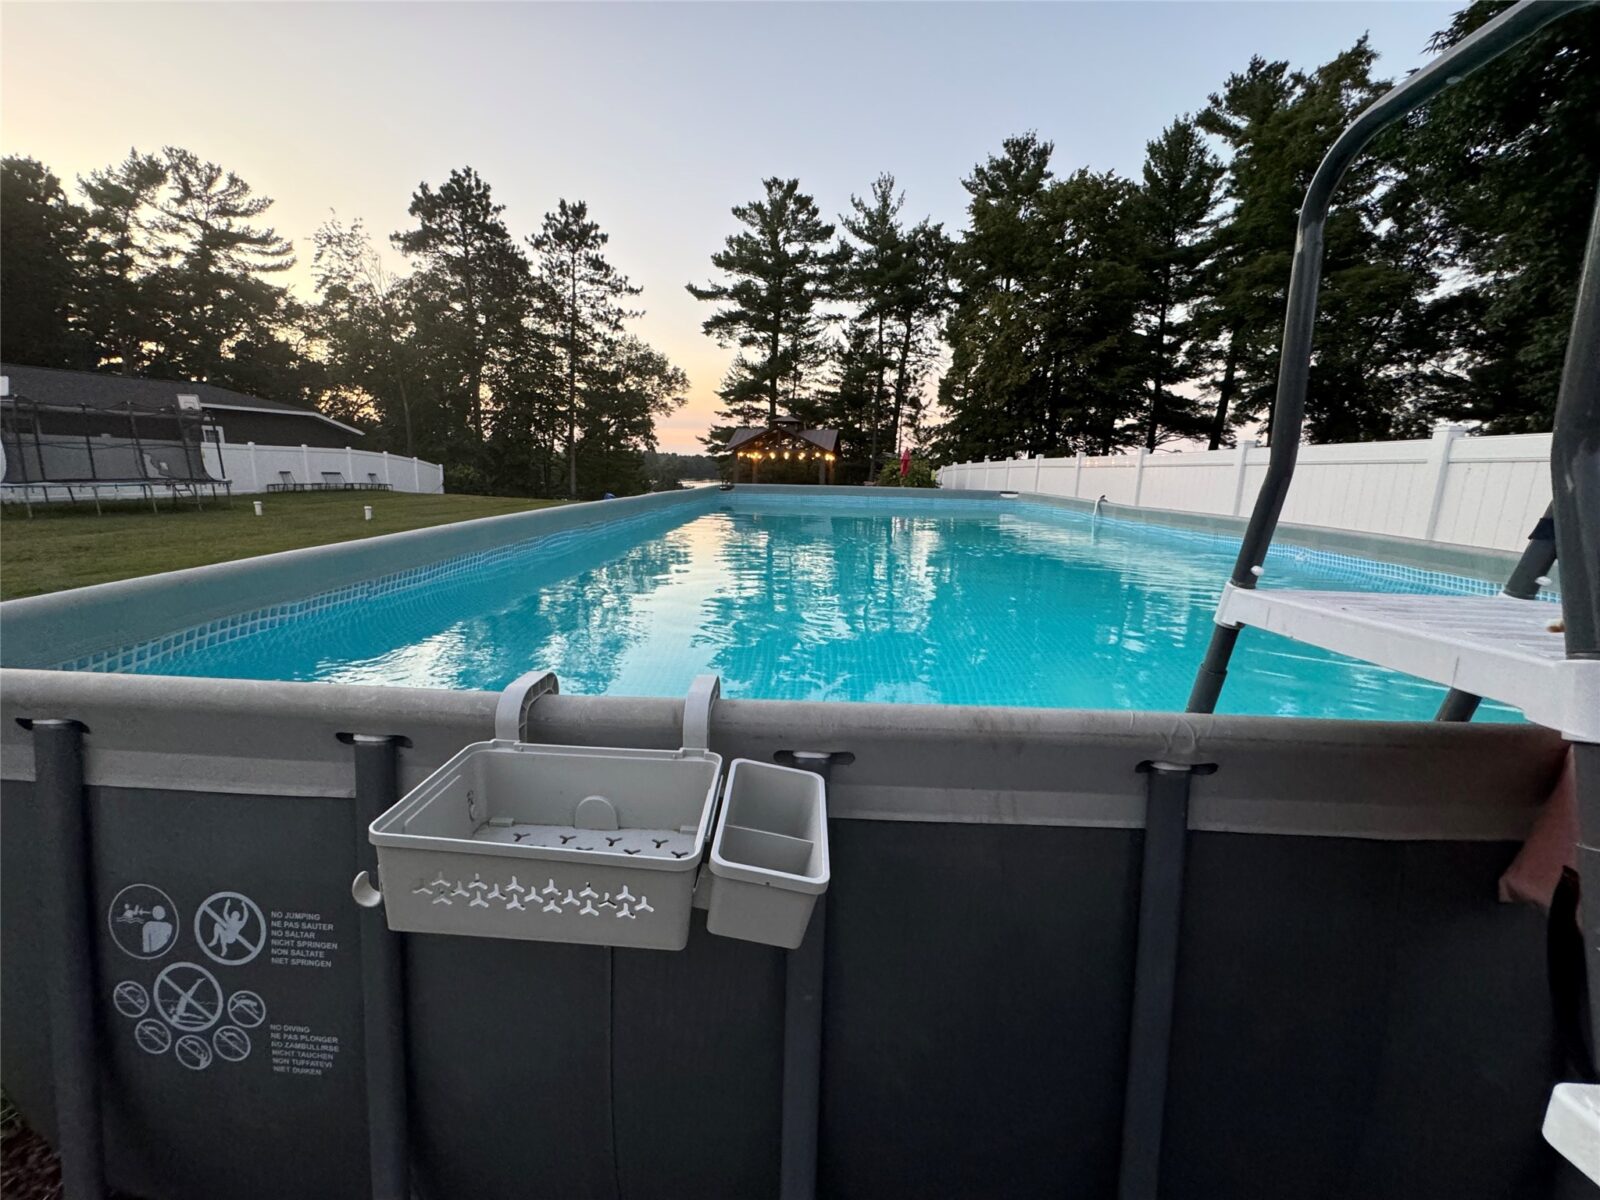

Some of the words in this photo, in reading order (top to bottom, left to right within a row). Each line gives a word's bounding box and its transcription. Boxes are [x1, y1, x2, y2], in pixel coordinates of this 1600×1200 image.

[285, 912, 320, 920] JUMPING
[301, 922, 334, 930] SAUTER
[284, 930, 316, 938] SALTAR
[297, 940, 338, 950] SPRINGEN
[290, 950, 325, 958] SALTATE
[291, 958, 332, 968] SPRINGEN
[300, 1034, 338, 1044] PLONGER
[284, 1042, 340, 1052] ZAMBULLIRSE
[296, 1051, 334, 1060] TAUCHEN
